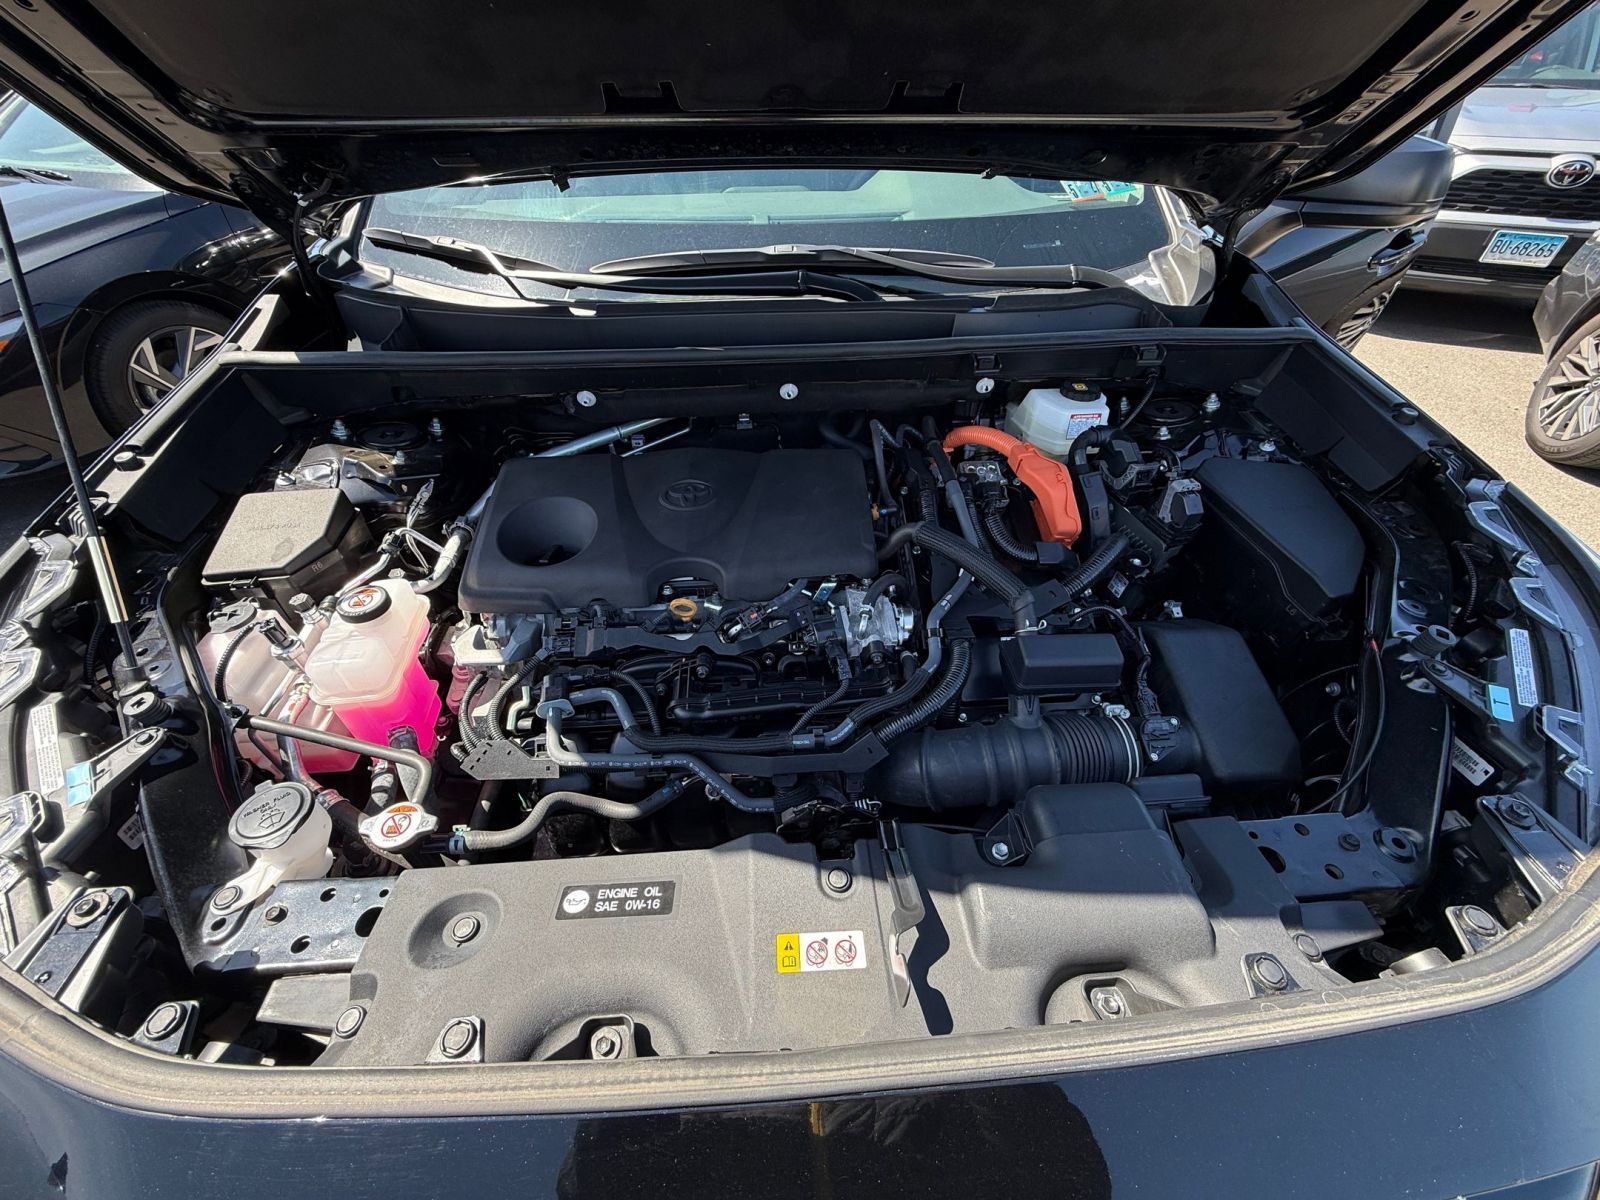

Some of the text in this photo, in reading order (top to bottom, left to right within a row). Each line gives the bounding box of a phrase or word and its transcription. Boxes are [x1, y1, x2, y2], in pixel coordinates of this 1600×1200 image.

[597, 886, 662, 899] ENGINE OIL
[594, 899, 660, 912] SAE 0W-16
